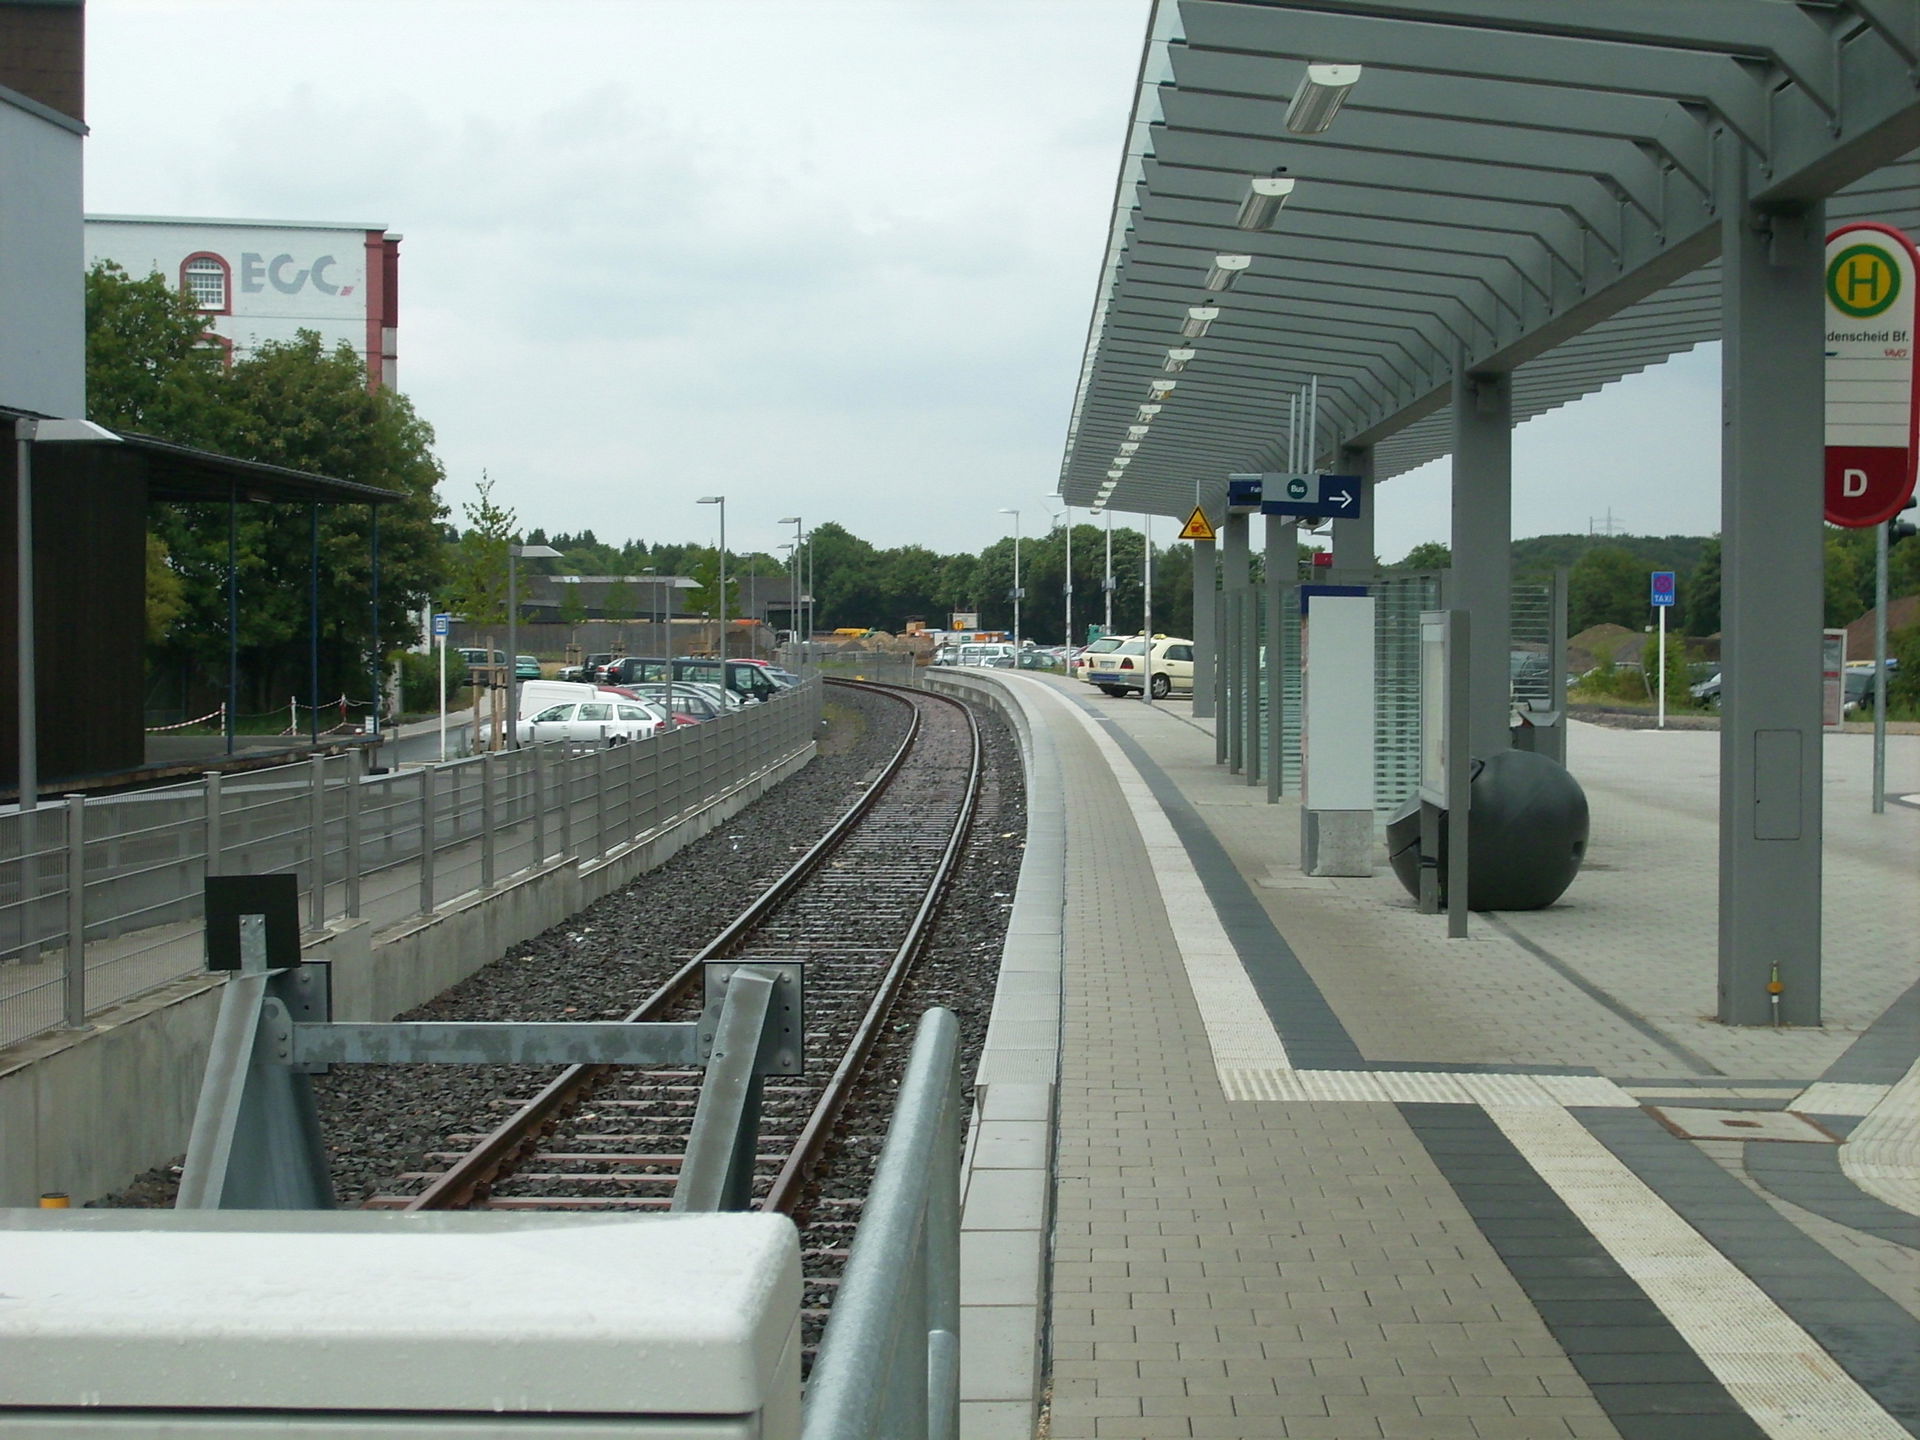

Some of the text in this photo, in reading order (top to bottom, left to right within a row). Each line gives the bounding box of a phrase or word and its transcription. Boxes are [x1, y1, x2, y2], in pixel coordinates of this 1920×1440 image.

[1847, 260, 1879, 302] H
[1826, 330, 1909, 342] denscheid Bf.
[1290, 484, 1305, 493] Bus
[1843, 468, 1868, 497] D
[1654, 594, 1673, 603] TAXI
